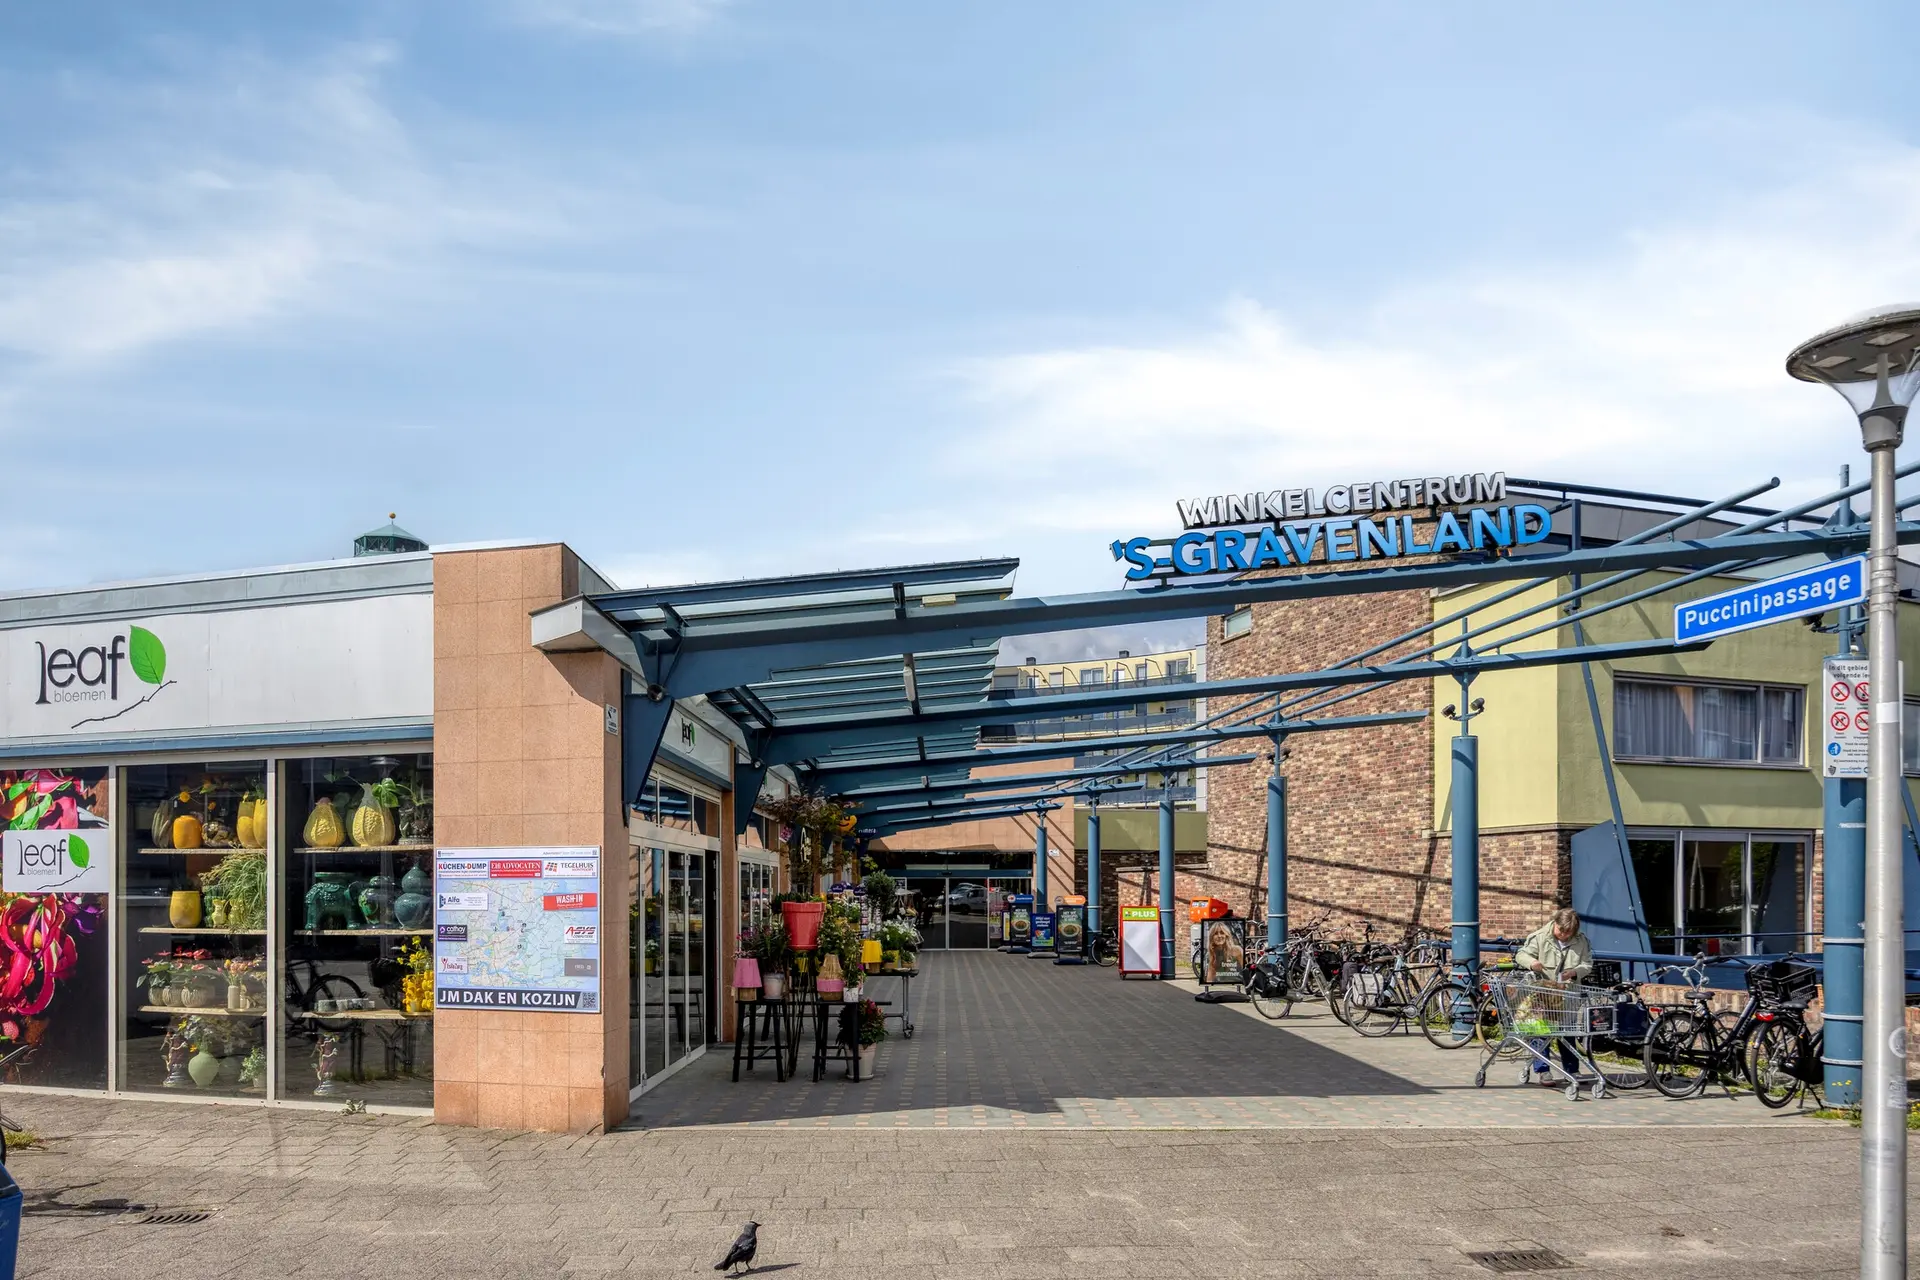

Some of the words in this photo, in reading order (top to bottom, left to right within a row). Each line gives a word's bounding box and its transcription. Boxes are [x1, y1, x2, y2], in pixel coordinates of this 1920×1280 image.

[1177, 472, 1507, 529] WINKELCENTRUM
[1684, 573, 1852, 630] Puccinipassage
[35, 635, 126, 705] leaf
[54, 689, 106, 703] bloemen
[17, 838, 66, 875] leaf
[438, 861, 487, 870] KÜCHEN-DUMP
[27, 867, 56, 876] bloemen
[440, 990, 460, 1003] JM
[463, 990, 494, 1004] DAK
[498, 992, 516, 1005] EN
[521, 993, 576, 1006] KOZIJN
